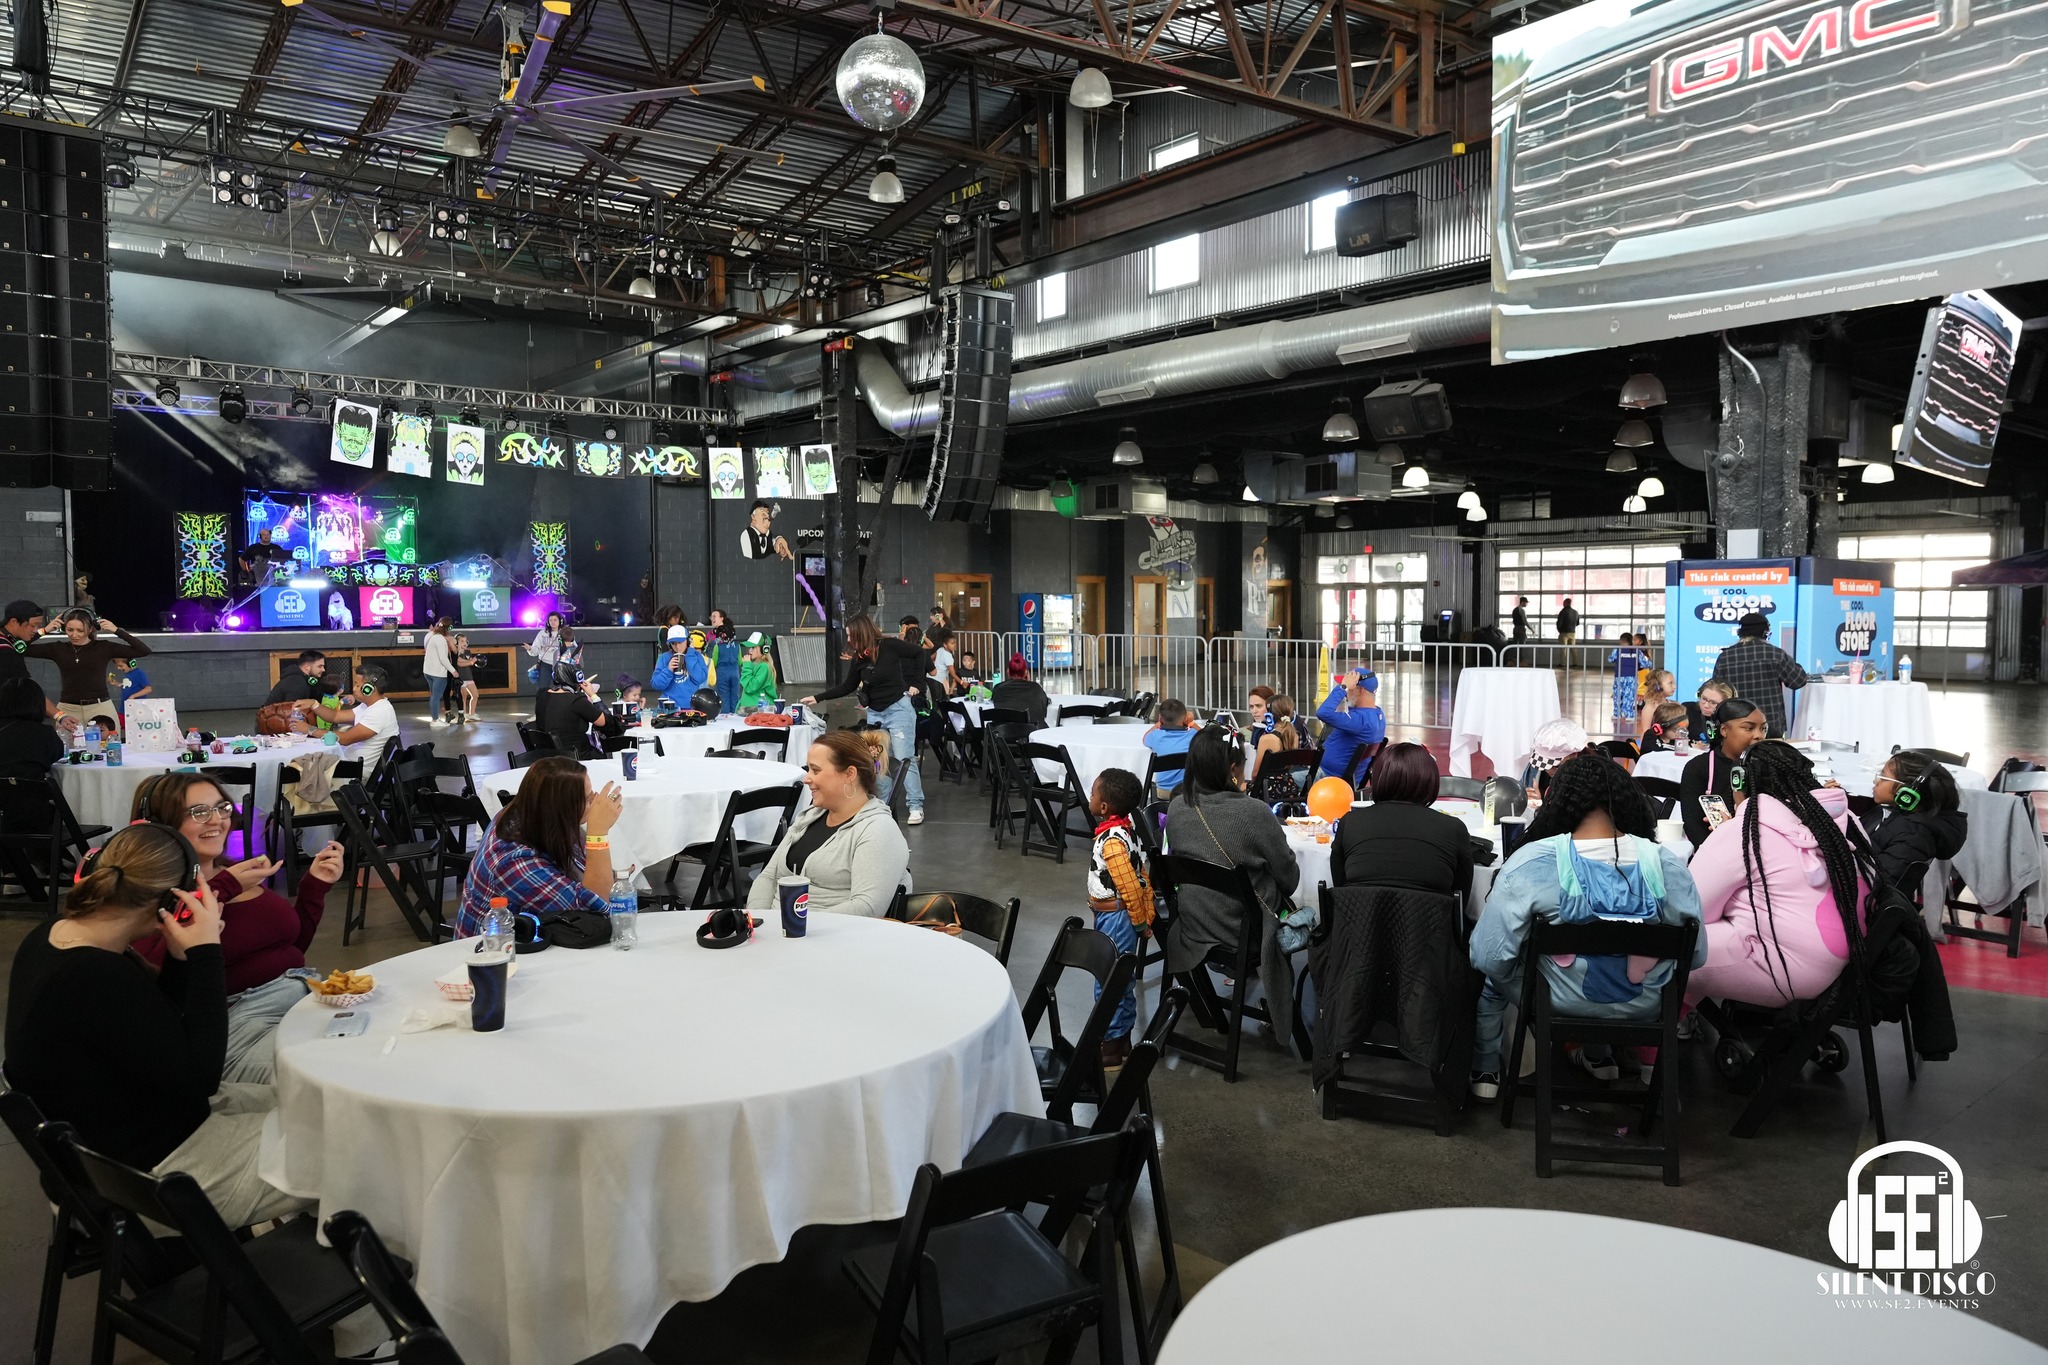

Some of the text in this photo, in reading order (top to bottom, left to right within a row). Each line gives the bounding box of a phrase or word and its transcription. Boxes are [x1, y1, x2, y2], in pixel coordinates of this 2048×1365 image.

[1668, 0, 1942, 101] GMC
[962, 181, 983, 199] TON
[1668, 270, 1939, 320] Professional Drivers. Closed Course. Available features and accessories shown throughout.
[1690, 571, 1783, 583] This rink created by
[1712, 595, 1773, 608] FLOOR
[1851, 601, 1864, 610] COOL
[1845, 611, 1876, 631] FLOOR
[1025, 623, 1035, 663] pepsi
[1839, 631, 1870, 652] STORE
[137, 722, 162, 730] YOU
